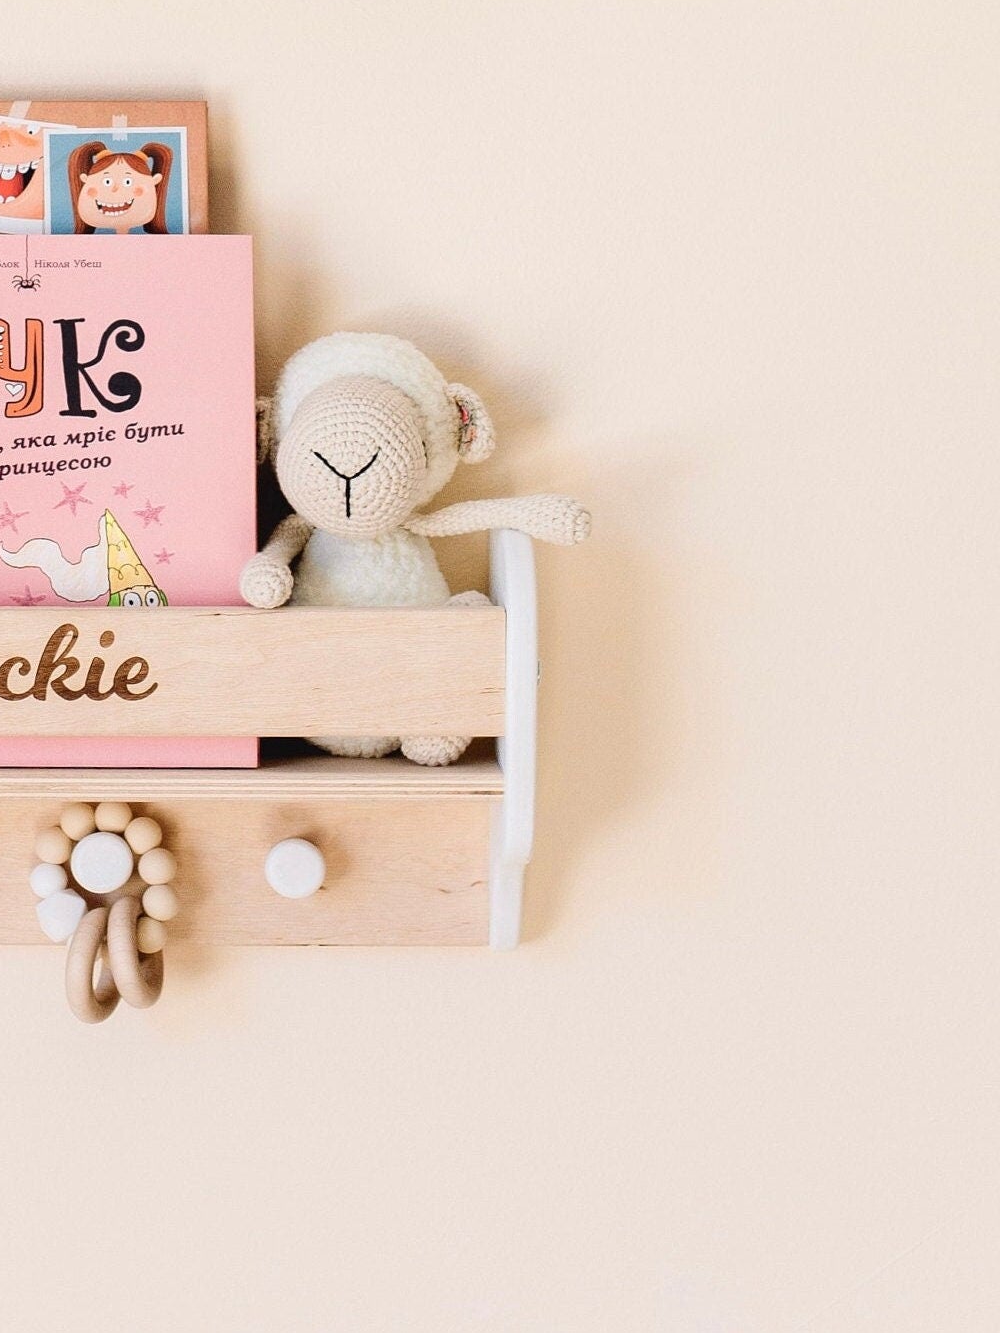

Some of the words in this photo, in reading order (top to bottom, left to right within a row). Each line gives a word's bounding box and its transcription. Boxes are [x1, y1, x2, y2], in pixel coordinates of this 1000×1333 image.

[34, 259, 70, 268] Ніколя
[73, 259, 102, 268] Убеш
[11, 435, 58, 450] яка
[63, 425, 117, 446] мріє
[123, 421, 186, 442] бути
